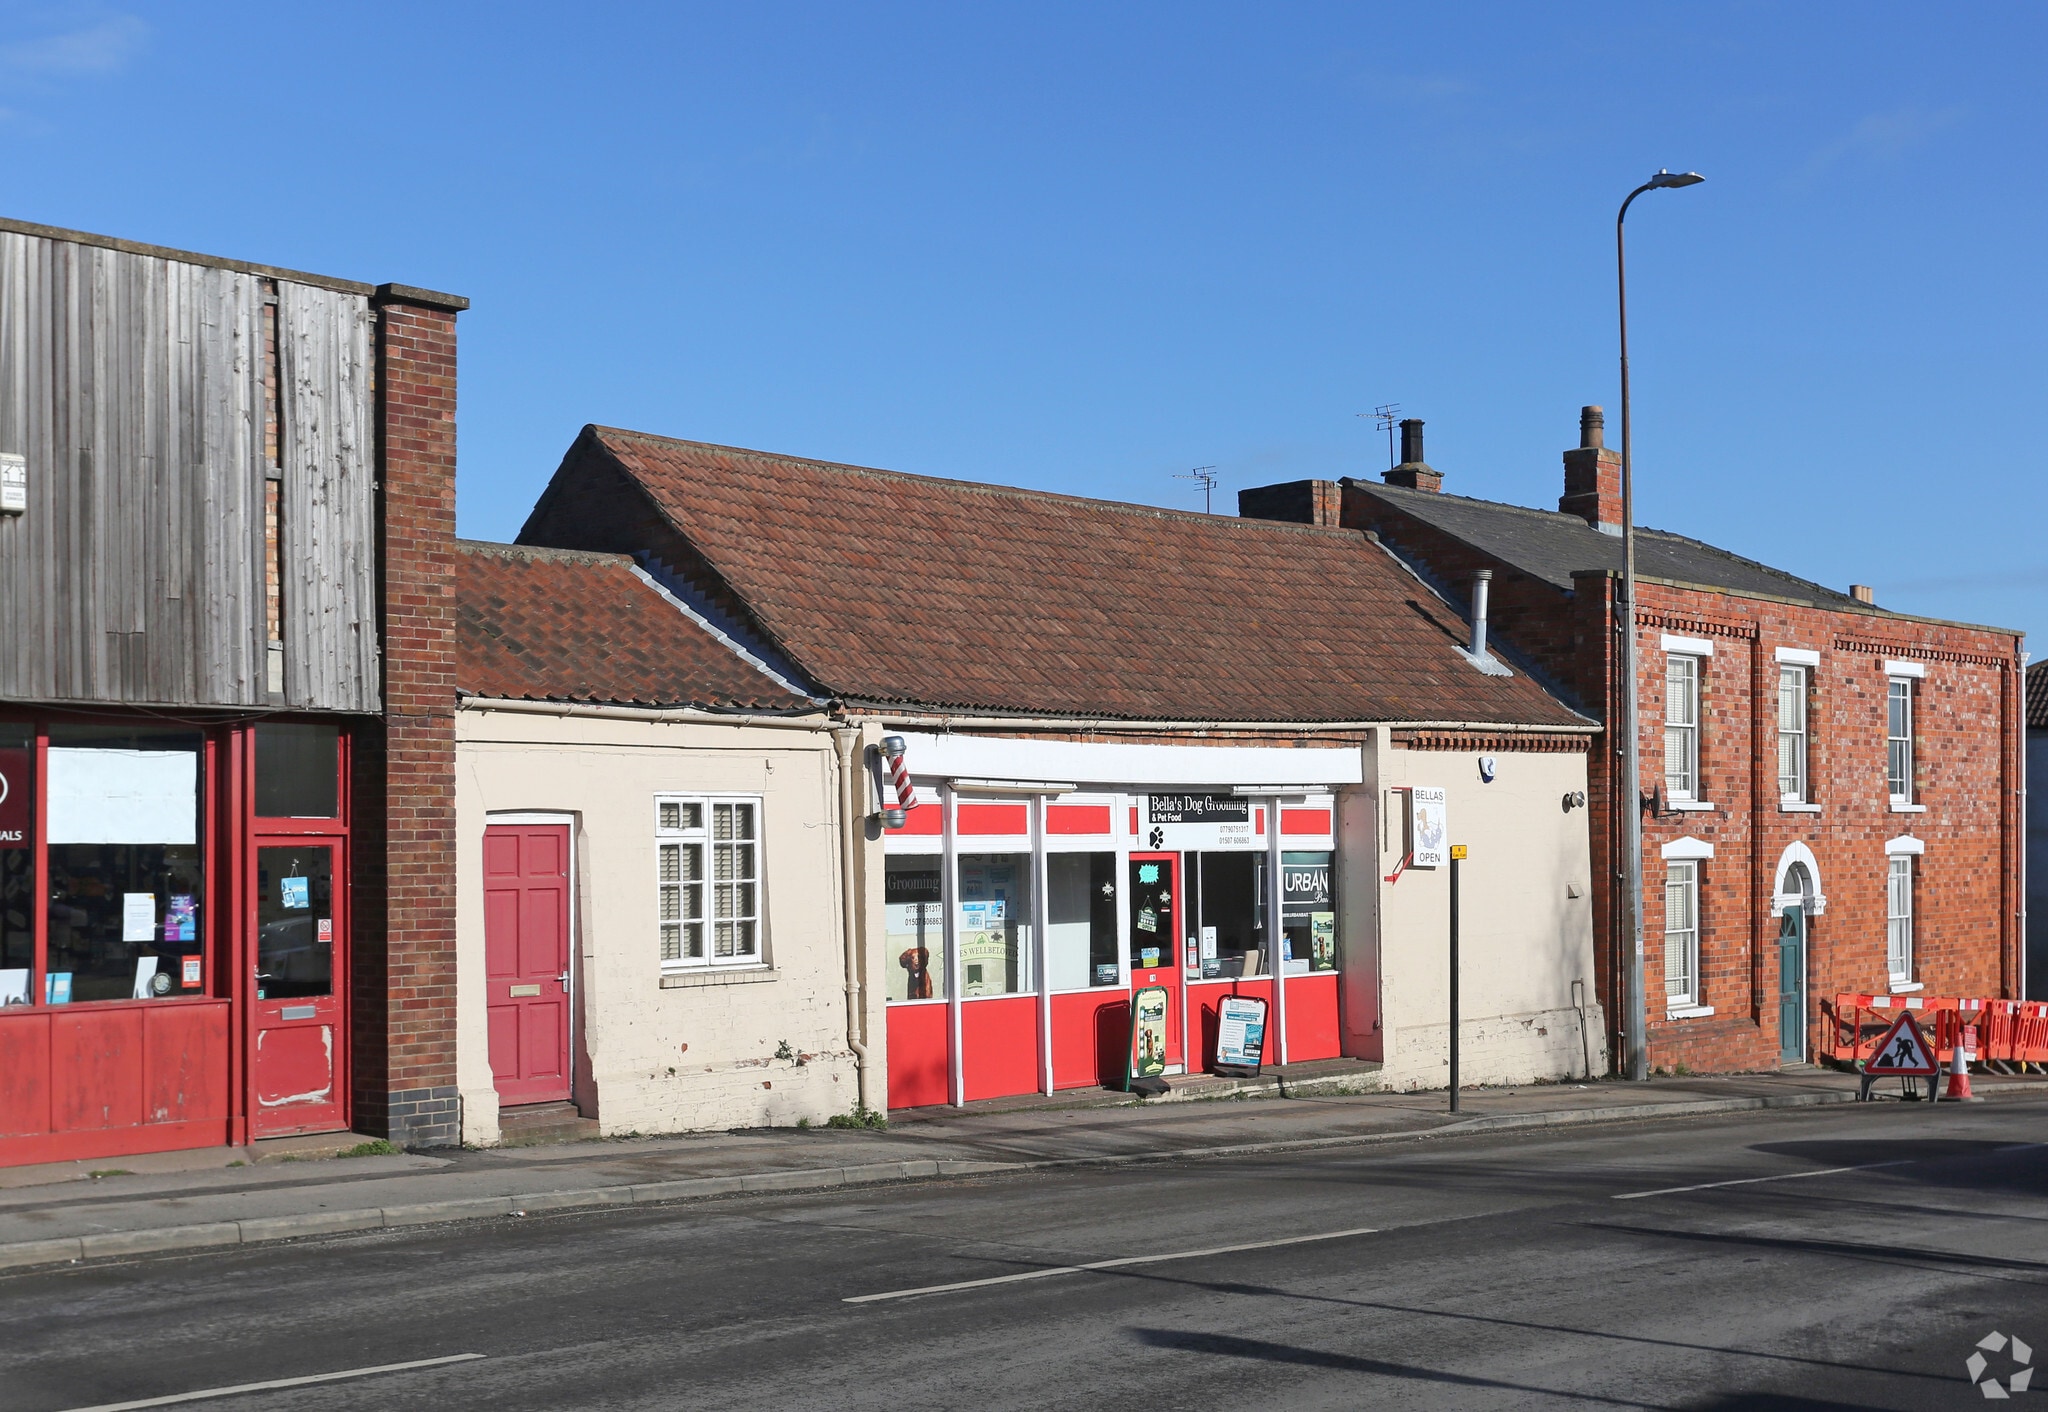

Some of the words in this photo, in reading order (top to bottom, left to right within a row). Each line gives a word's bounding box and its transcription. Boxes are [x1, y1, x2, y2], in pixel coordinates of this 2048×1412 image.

[1415, 789, 1444, 801] BELLAS
[1150, 795, 1182, 811] Bella's
[1184, 795, 1203, 815] Dog
[1204, 795, 1247, 814] Grooming
[1151, 813, 1156, 822] &
[1157, 813, 1167, 822] Pet
[1167, 813, 1182, 822] Food
[0, 830, 23, 841] ALS
[1419, 852, 1441, 863] OPEN
[887, 874, 940, 893] Grooming
[1285, 869, 1329, 894] URBAN
